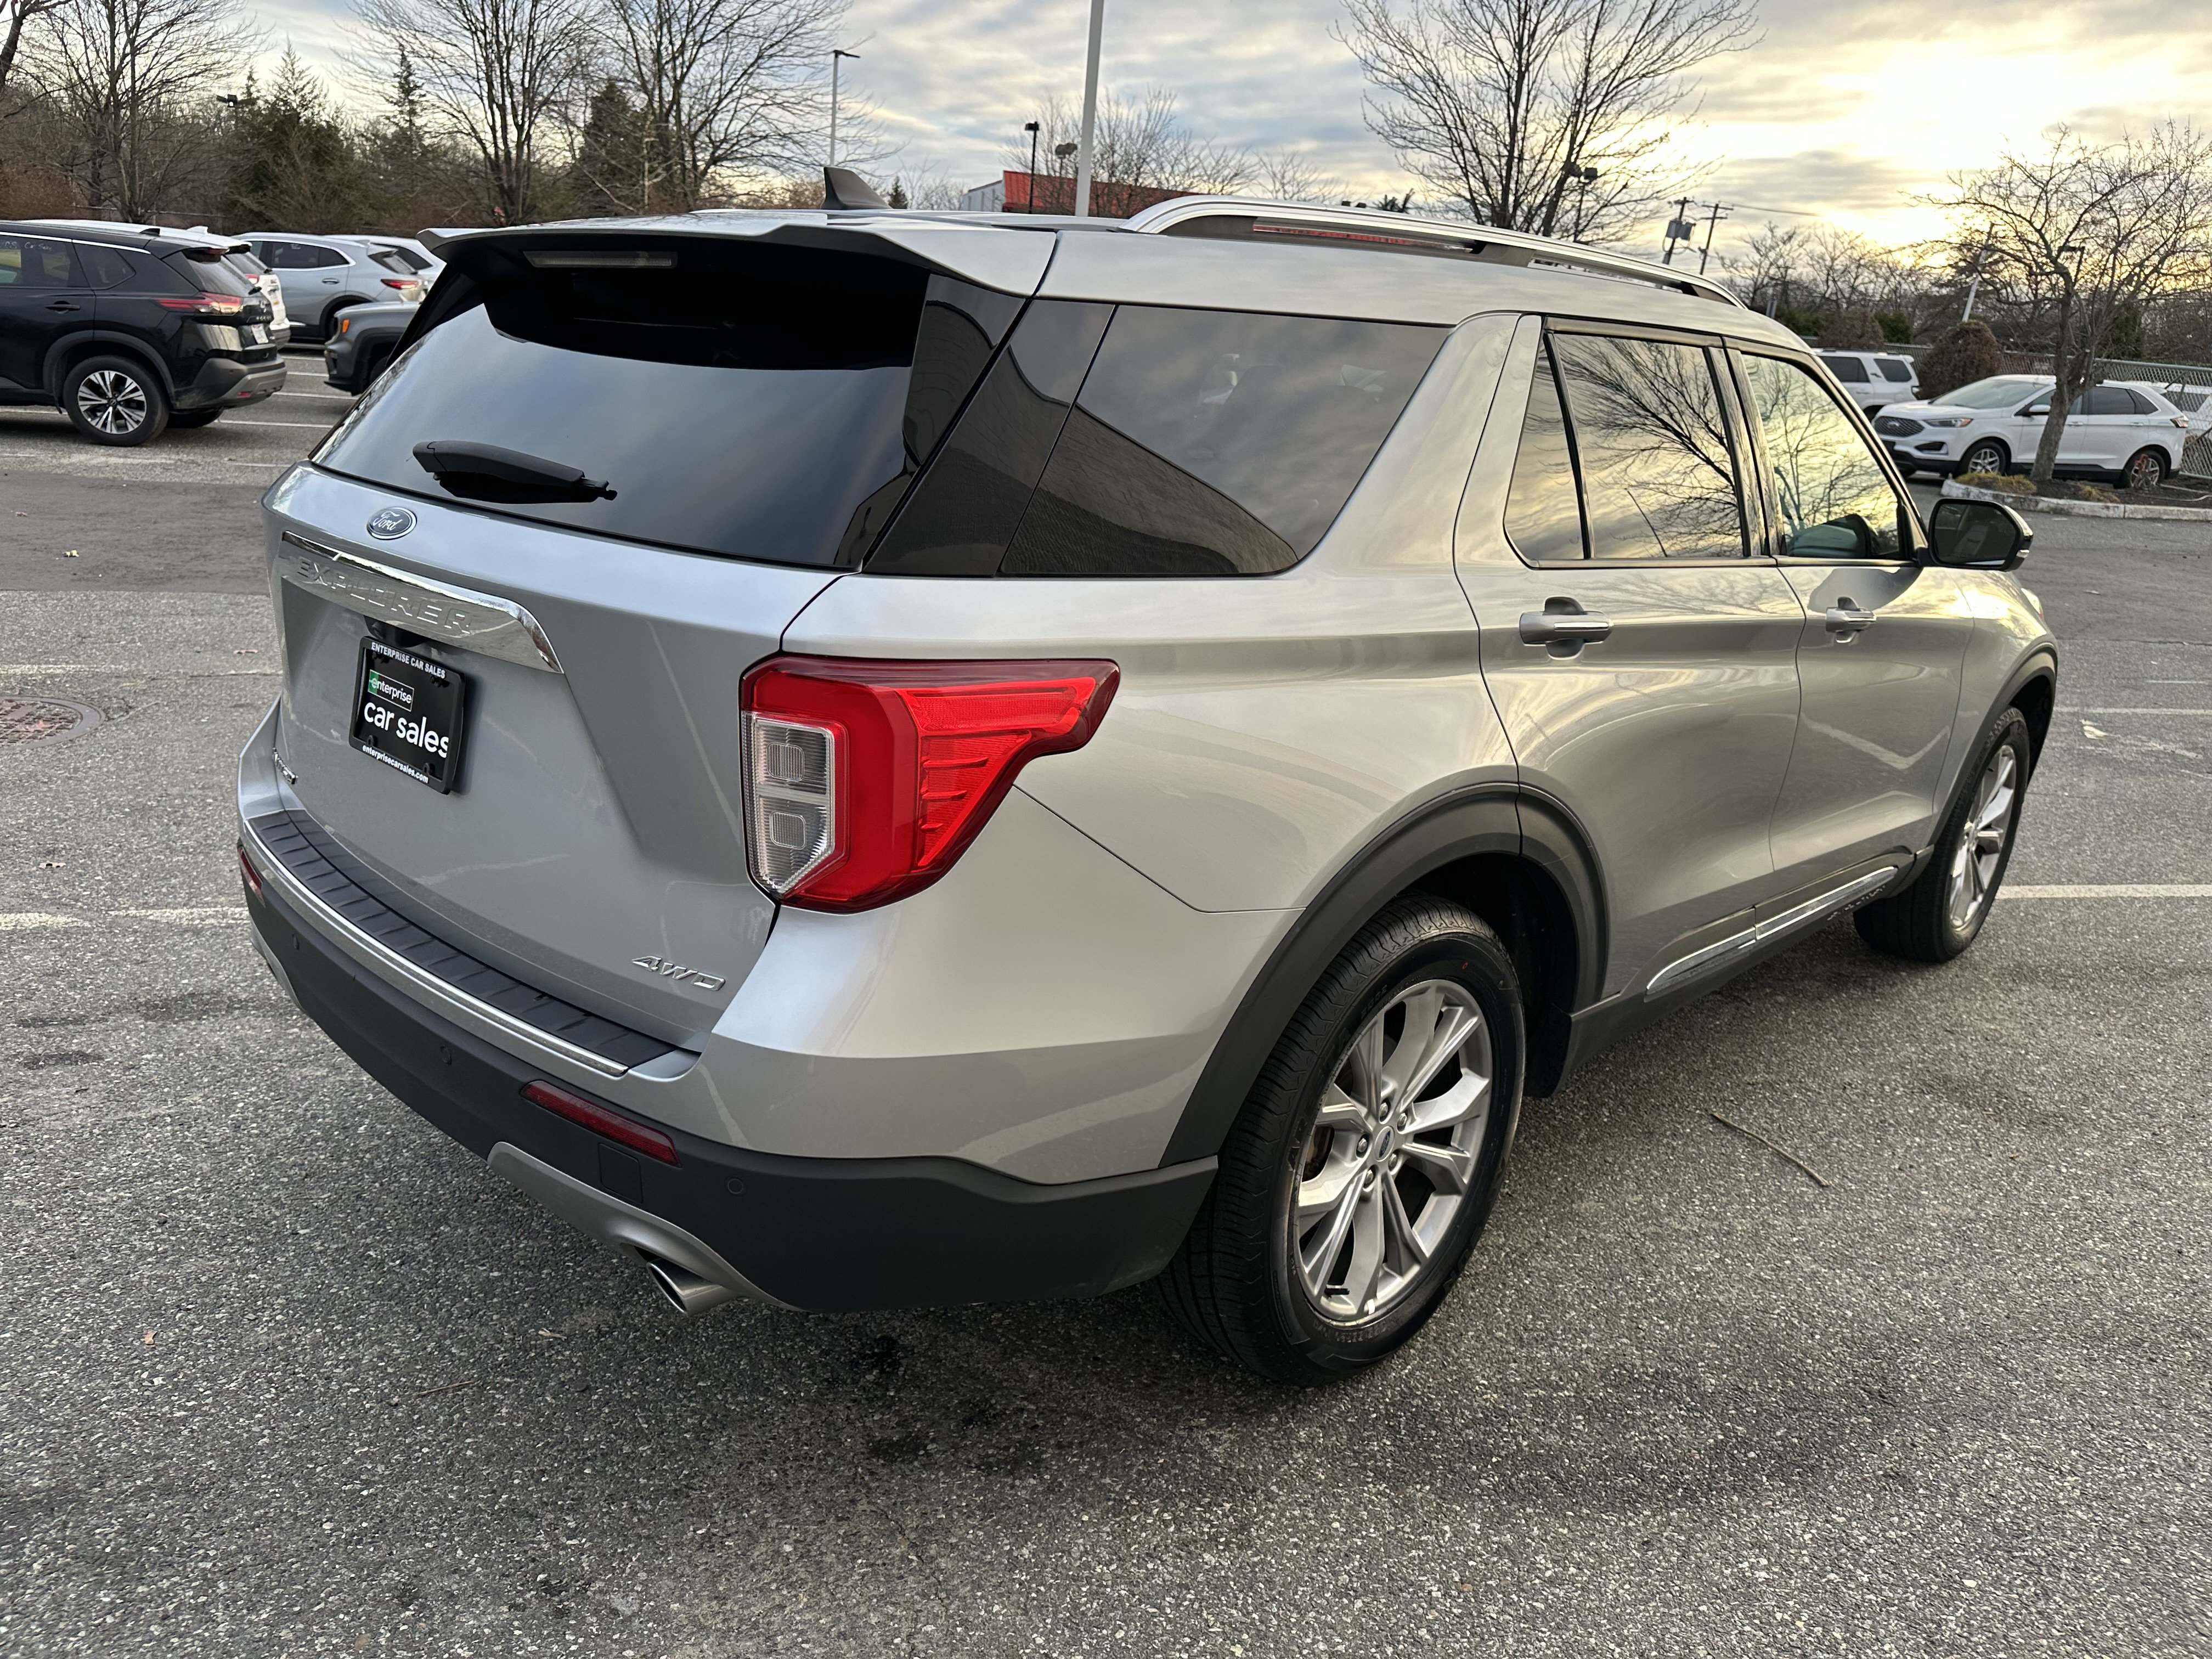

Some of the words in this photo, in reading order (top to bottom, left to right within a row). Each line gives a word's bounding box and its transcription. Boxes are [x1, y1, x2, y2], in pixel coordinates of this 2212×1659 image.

[373, 511, 403, 531] Ford
[297, 557, 471, 634] EXPLORER
[371, 641, 410, 665] ENTERPRISE
[411, 657, 424, 671] CAR
[425, 663, 446, 679] SALES
[369, 678, 412, 704] enterprise
[364, 702, 395, 731] car
[396, 716, 449, 758] sales
[362, 744, 429, 783] enterprisecarsales.com
[631, 955, 725, 991] 4WD
